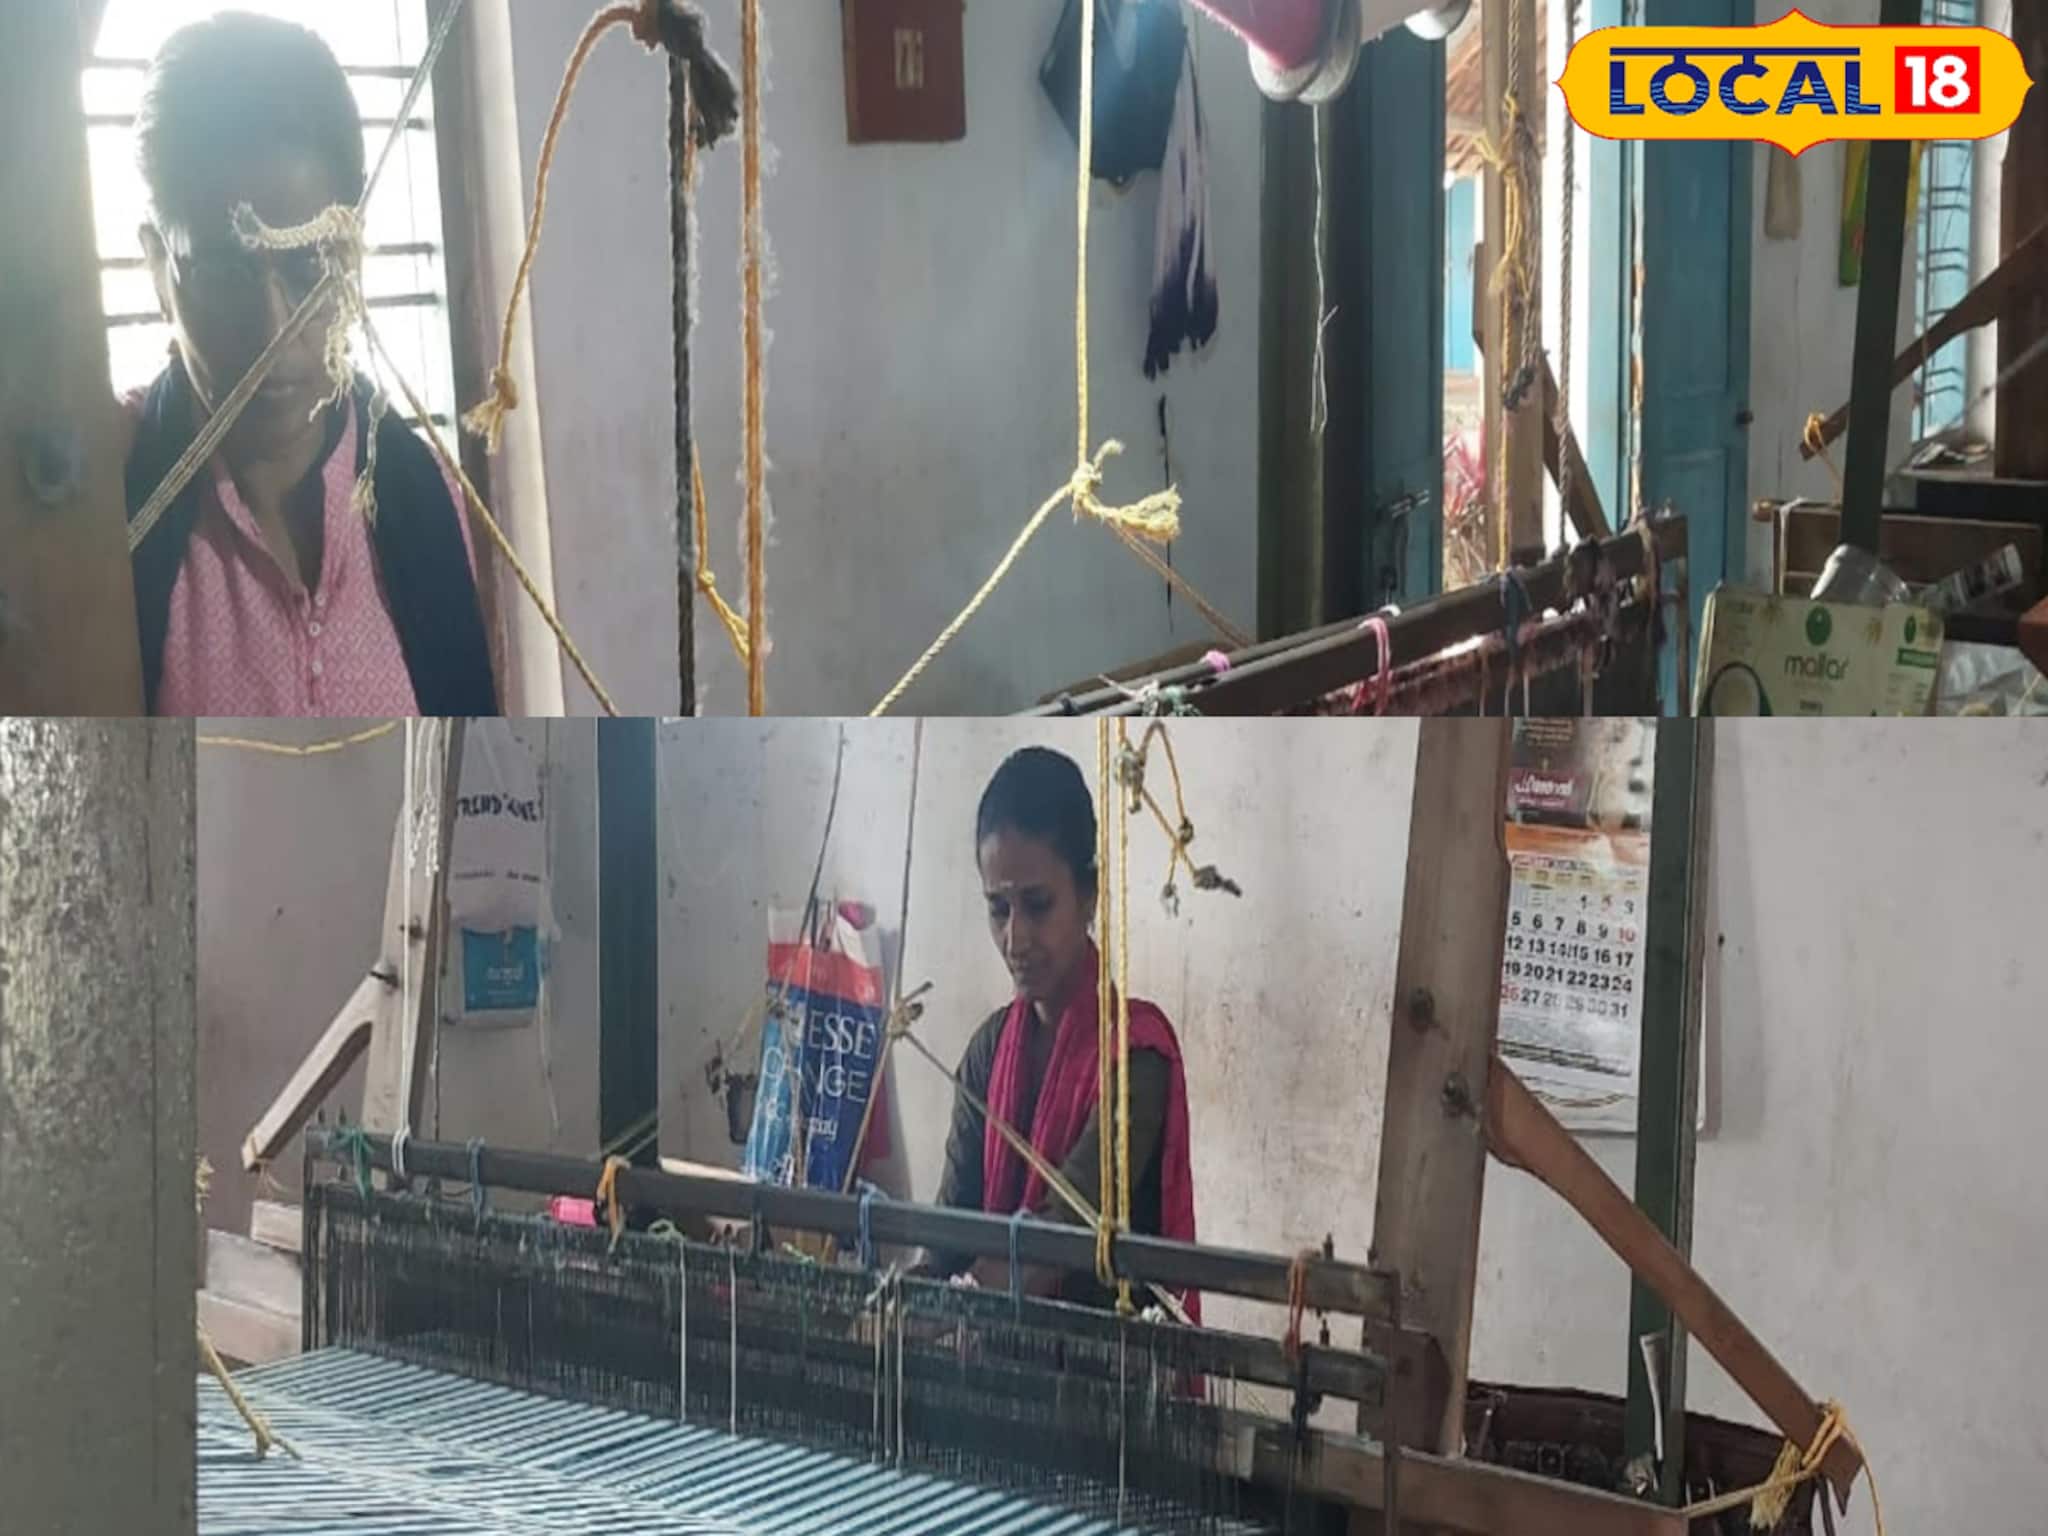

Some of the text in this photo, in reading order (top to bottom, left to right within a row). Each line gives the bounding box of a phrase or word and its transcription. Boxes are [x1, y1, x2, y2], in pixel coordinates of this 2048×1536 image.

[1511, 911, 1522, 926] 5
[1532, 914, 1543, 930] 6
[1555, 917, 1565, 931] 7
[1507, 935, 1523, 951] 12
[1528, 938, 1545, 953] 13
[1594, 948, 1611, 964] 16
[1616, 951, 1634, 967] 17
[1505, 961, 1633, 993] 19 20 21 22 23 24
[1521, 989, 1539, 1005] 27
